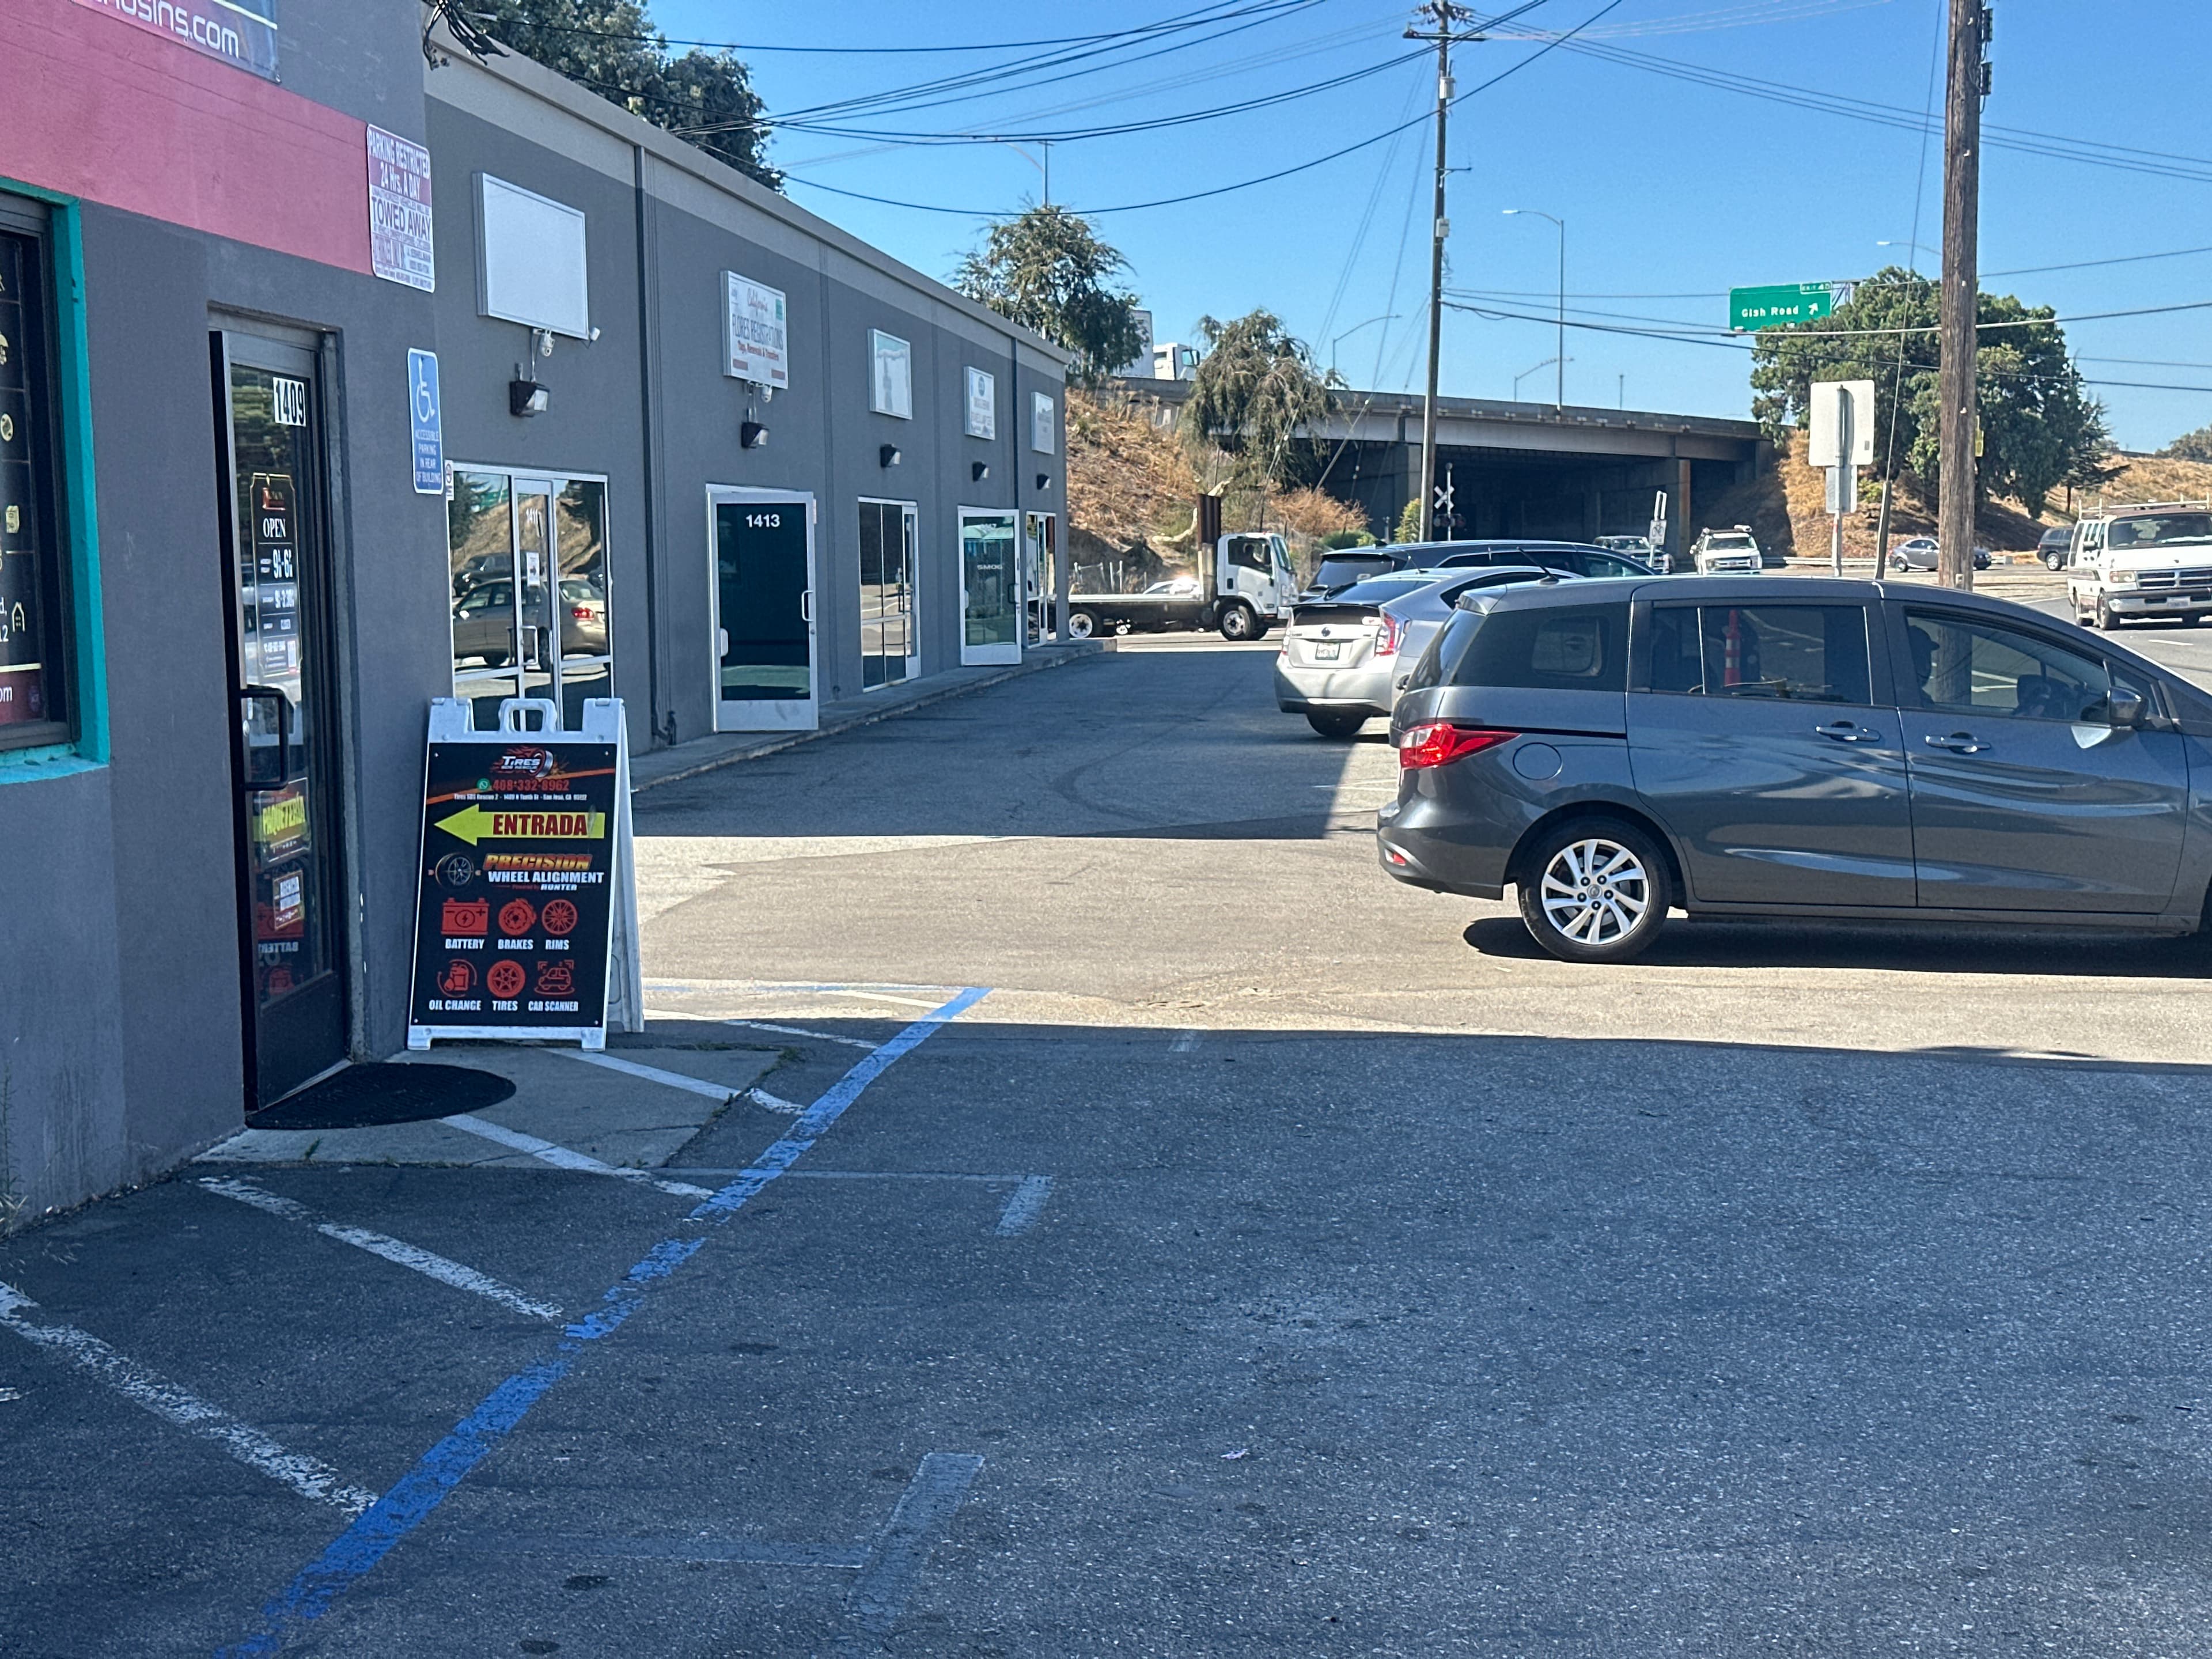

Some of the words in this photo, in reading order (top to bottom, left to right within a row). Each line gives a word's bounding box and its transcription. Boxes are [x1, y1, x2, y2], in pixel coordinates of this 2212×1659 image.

[369, 127, 395, 165] PARKING
[396, 141, 430, 179] RESTRICTED
[380, 161, 389, 190] 24
[389, 164, 403, 194] Hrs.
[403, 171, 408, 196] A
[408, 172, 421, 201] DAY
[372, 196, 405, 232] TOWED
[407, 210, 431, 241] AWAY
[1741, 308, 1766, 317] Gish
[1771, 305, 1798, 316] Road
[732, 313, 749, 340] FLORES
[276, 380, 304, 425] 1409
[415, 429, 439, 442] ACCESSIBLE
[418, 443, 437, 456] PARKING
[263, 518, 286, 537] OPEN
[745, 514, 781, 528] 1413
[493, 814, 588, 835] ENTRADA
[483, 854, 593, 870] PRECISION
[488, 872, 530, 882] WHEEL
[532, 872, 604, 883] ALIGNMENT
[445, 938, 485, 949] BATTERY
[497, 939, 533, 950] BRAKES
[545, 939, 570, 950] RIMS
[429, 999, 443, 1010] OIL
[445, 999, 482, 1010] CHANGE
[492, 1000, 518, 1011] TIRES
[528, 1001, 543, 1012] CAR
[544, 1001, 578, 1012] SCANNER
